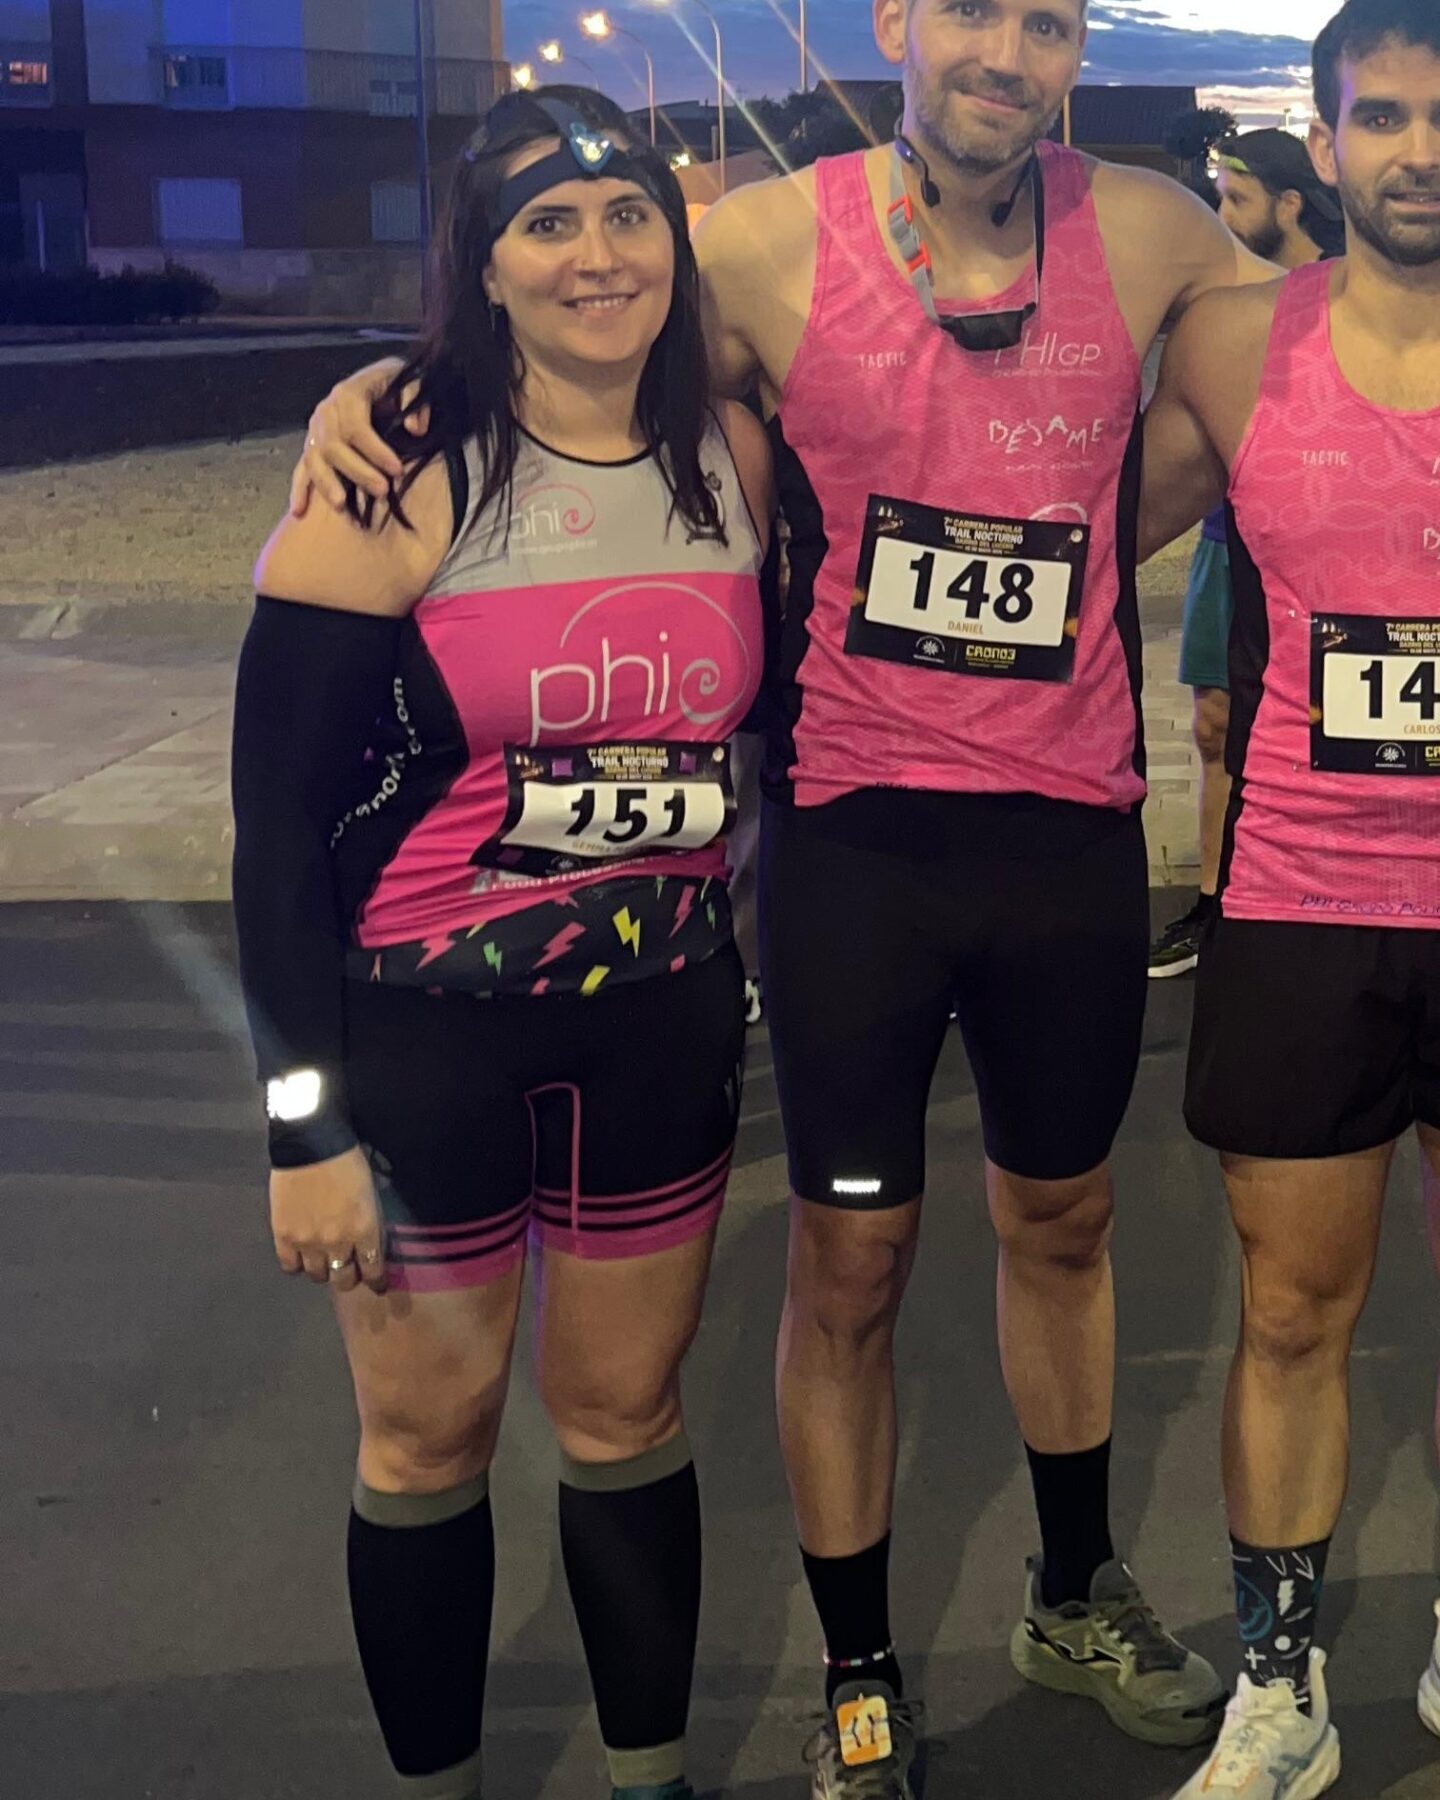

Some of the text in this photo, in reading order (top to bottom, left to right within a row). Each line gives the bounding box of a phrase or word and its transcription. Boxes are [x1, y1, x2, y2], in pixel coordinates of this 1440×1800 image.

[945, 526, 1024, 545] TRAIL NOCTURNO
[909, 552, 1034, 624] 148
[947, 620, 984, 635] DANIEL
[1388, 631, 1415, 642] TRAIL
[565, 788, 687, 844] 151
